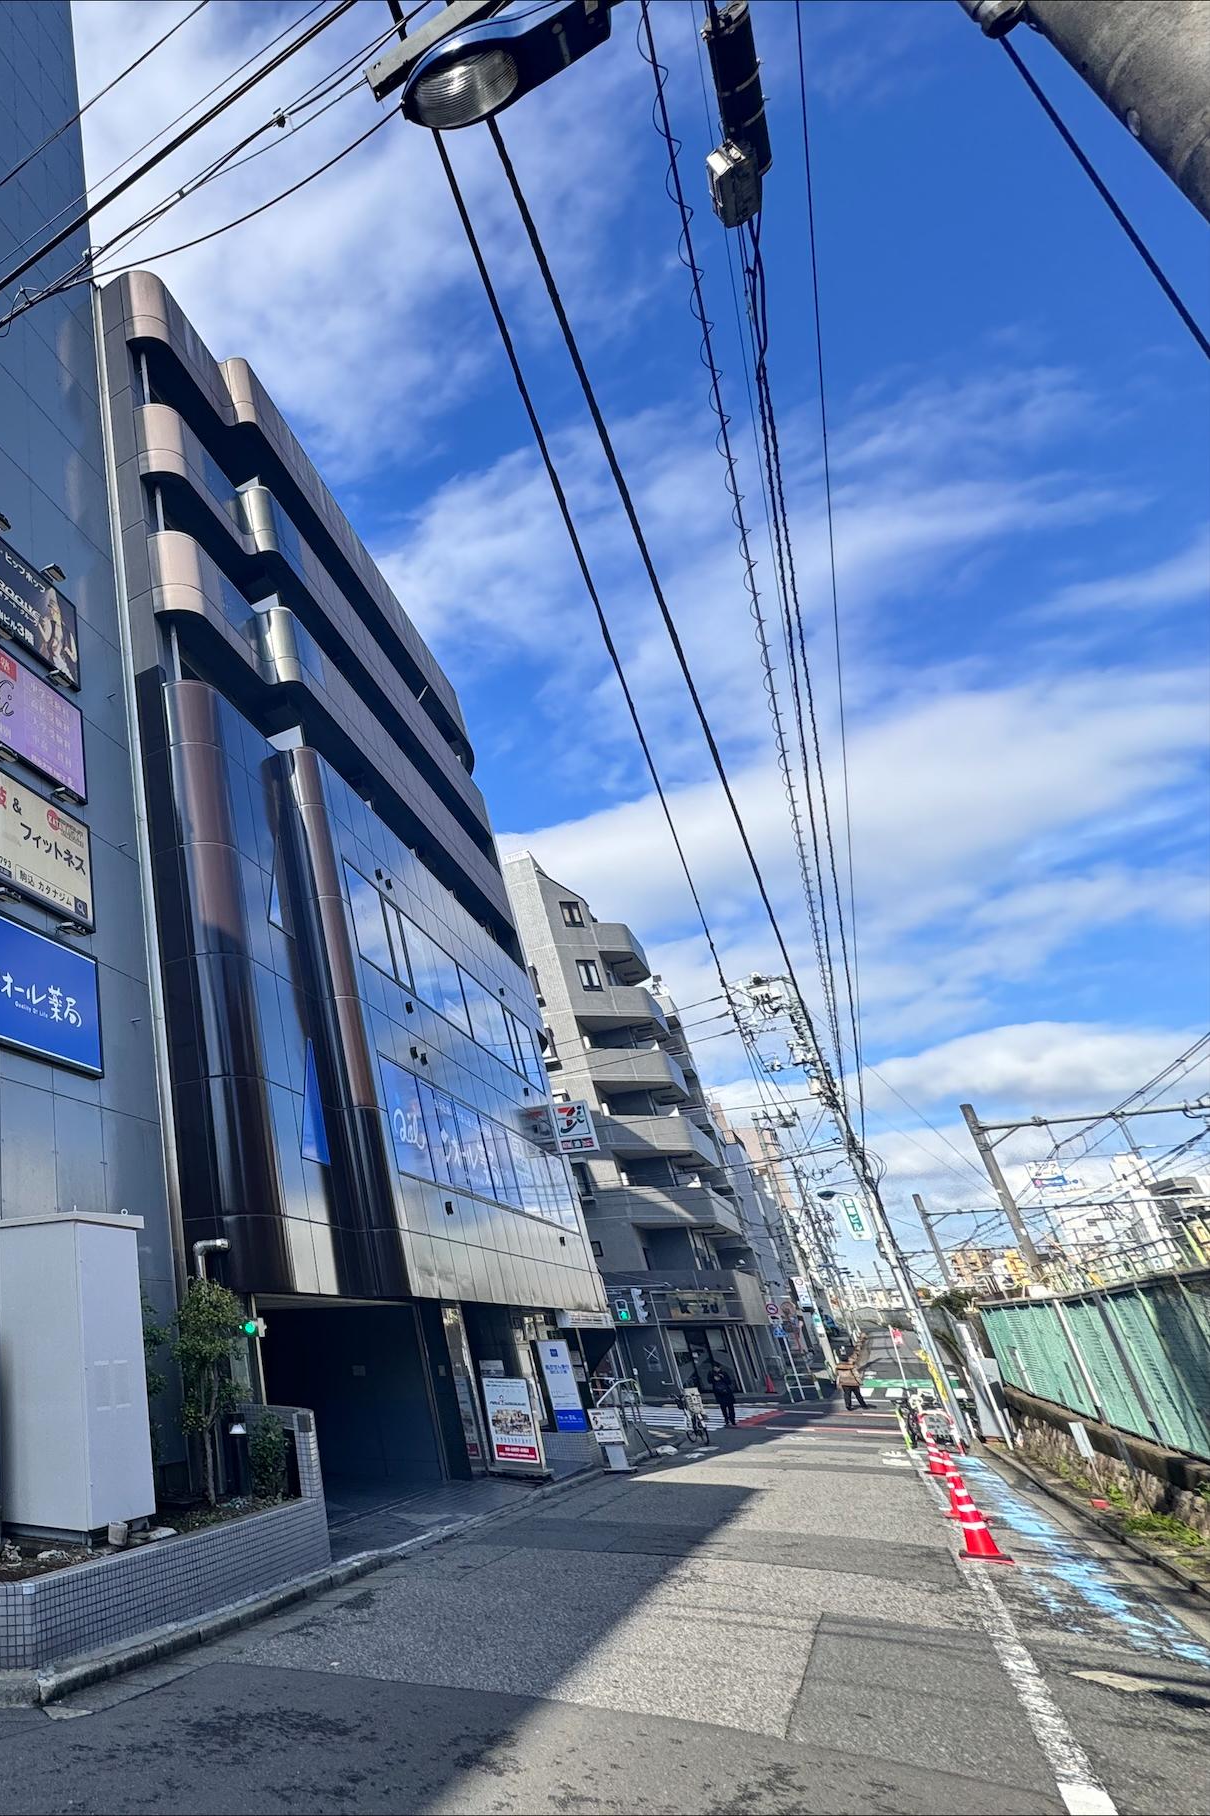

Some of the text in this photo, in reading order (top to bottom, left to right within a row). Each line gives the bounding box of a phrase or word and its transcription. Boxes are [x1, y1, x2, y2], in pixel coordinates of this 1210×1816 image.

[12, 797, 23, 815] &
[20, 822, 86, 876] フィットネス
[19, 870, 73, 907] 駒込 カタナジム
